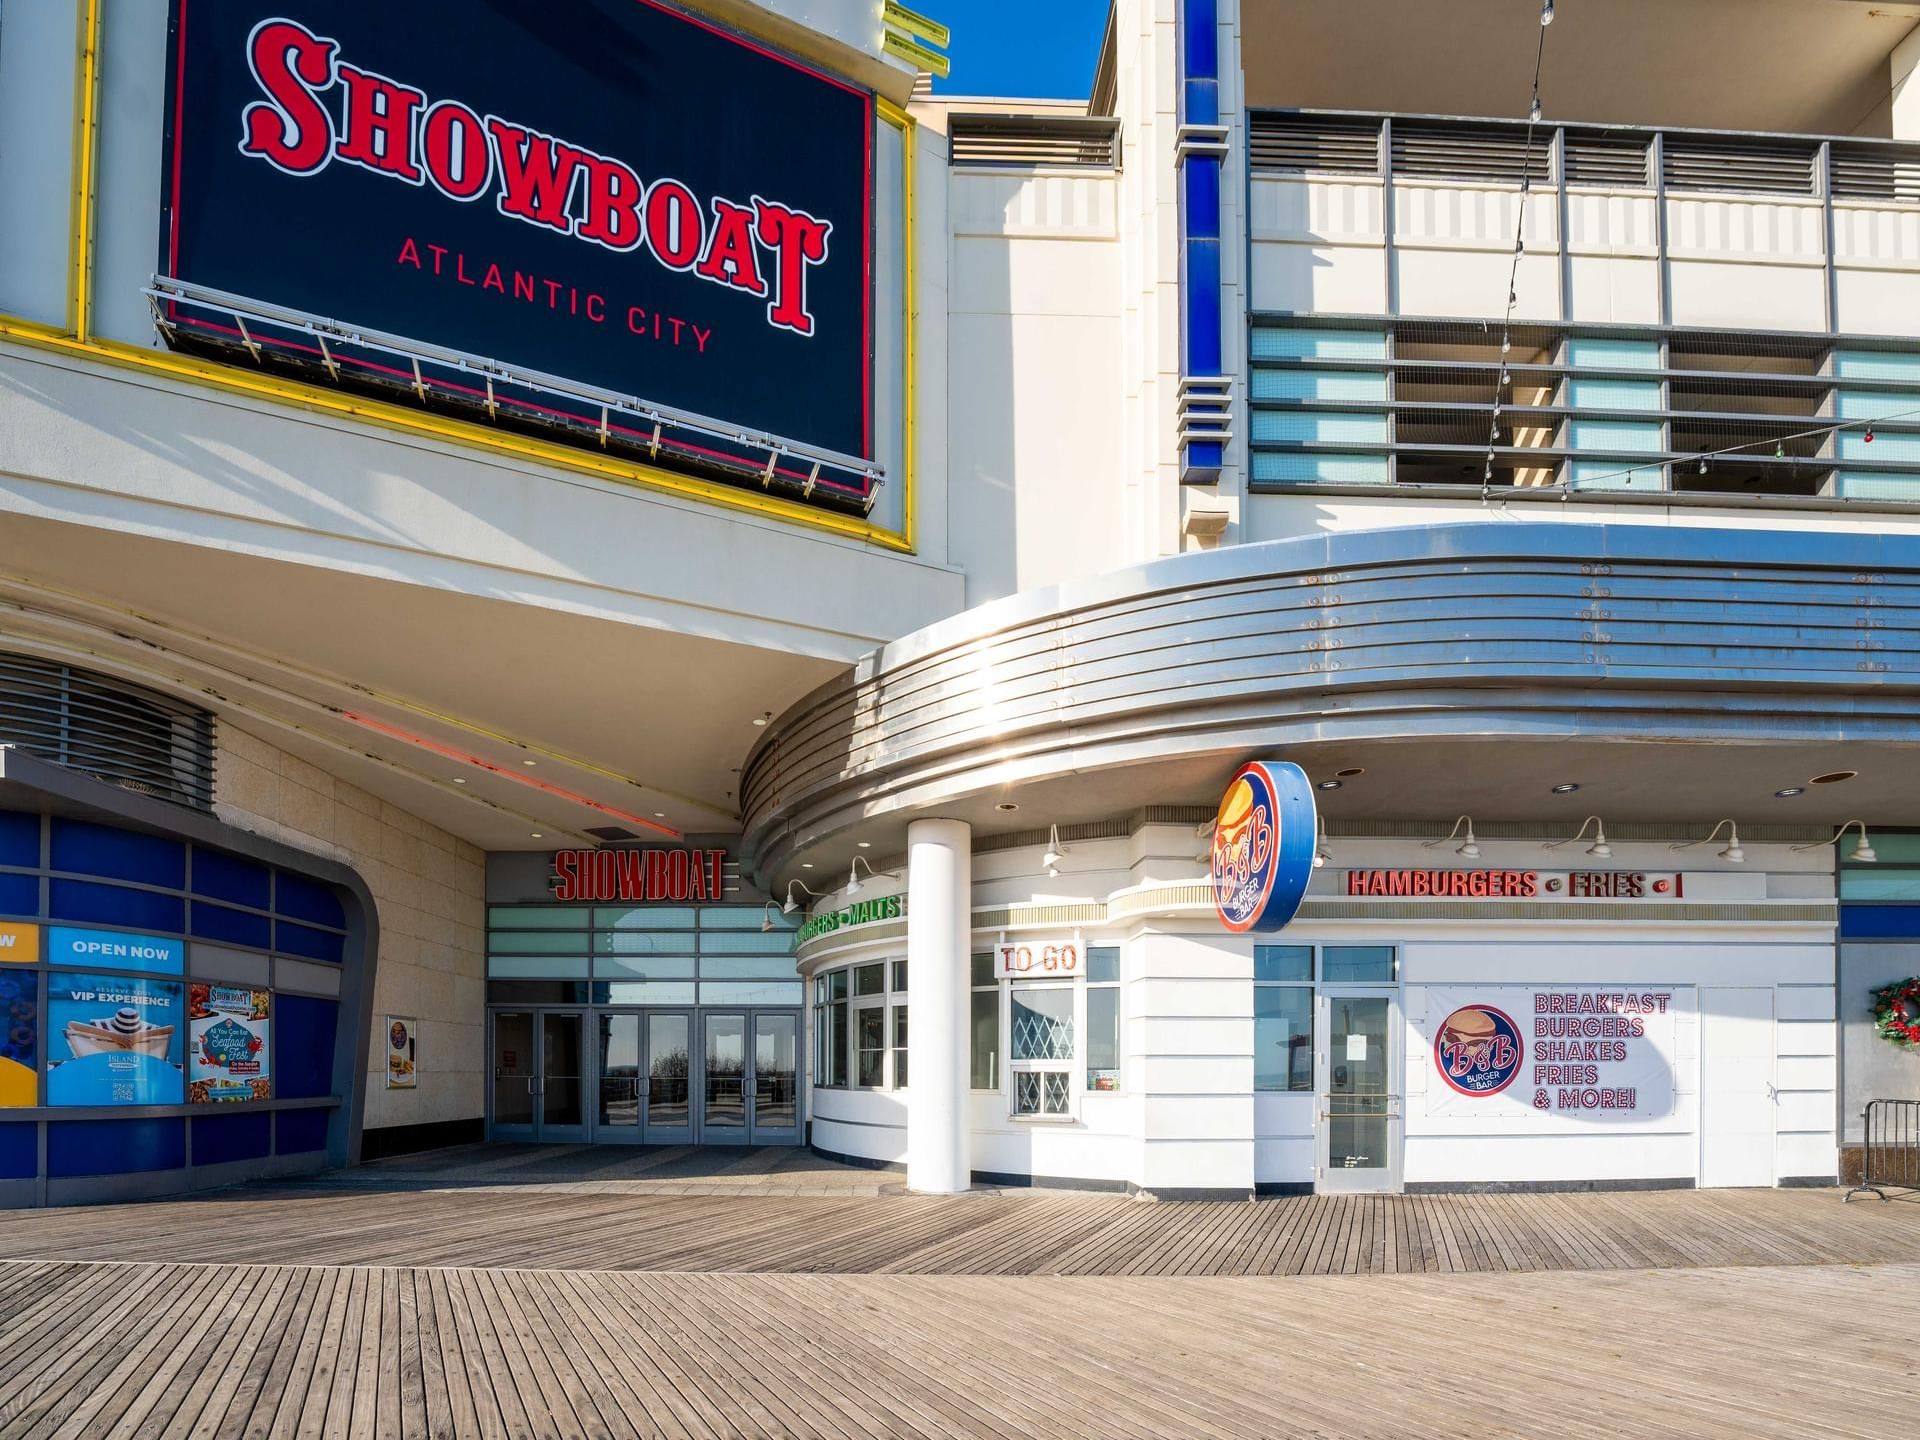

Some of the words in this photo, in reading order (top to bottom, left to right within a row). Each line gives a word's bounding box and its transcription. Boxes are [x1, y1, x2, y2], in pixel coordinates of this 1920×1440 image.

[239, 17, 833, 338] SHOWBOAT
[398, 238, 606, 323] ATLANTIC
[628, 307, 712, 354] CITY
[1216, 804, 1272, 904] B&B
[555, 849, 727, 901] SHOWBOAT
[1349, 871, 1537, 897] HAMBURGERS
[1569, 871, 1646, 898] FRIES
[1232, 878, 1259, 909] BURGER
[847, 895, 901, 926] MALTS
[1239, 900, 1254, 920] BAR
[72, 940, 127, 956] OPEN
[131, 946, 169, 961] NOW
[1001, 946, 1032, 972] TO
[1043, 944, 1077, 971] GO
[71, 991, 96, 1001] VIP
[98, 993, 170, 1007] EXPERIENCE
[1534, 994, 1671, 1014] BREAKFAST
[1534, 1018, 1645, 1038] BURGERS
[212, 1034, 246, 1051] Seafood
[1534, 1042, 1627, 1062] SHAKES
[228, 1047, 249, 1060] Fest
[1444, 1034, 1517, 1077] B&B
[1466, 1071, 1500, 1084] BURGER
[1475, 1081, 1493, 1090] BAR
[1534, 1065, 1599, 1086] FRIES
[1533, 1089, 1550, 1109] &
[1557, 1088, 1637, 1109] MORE!
